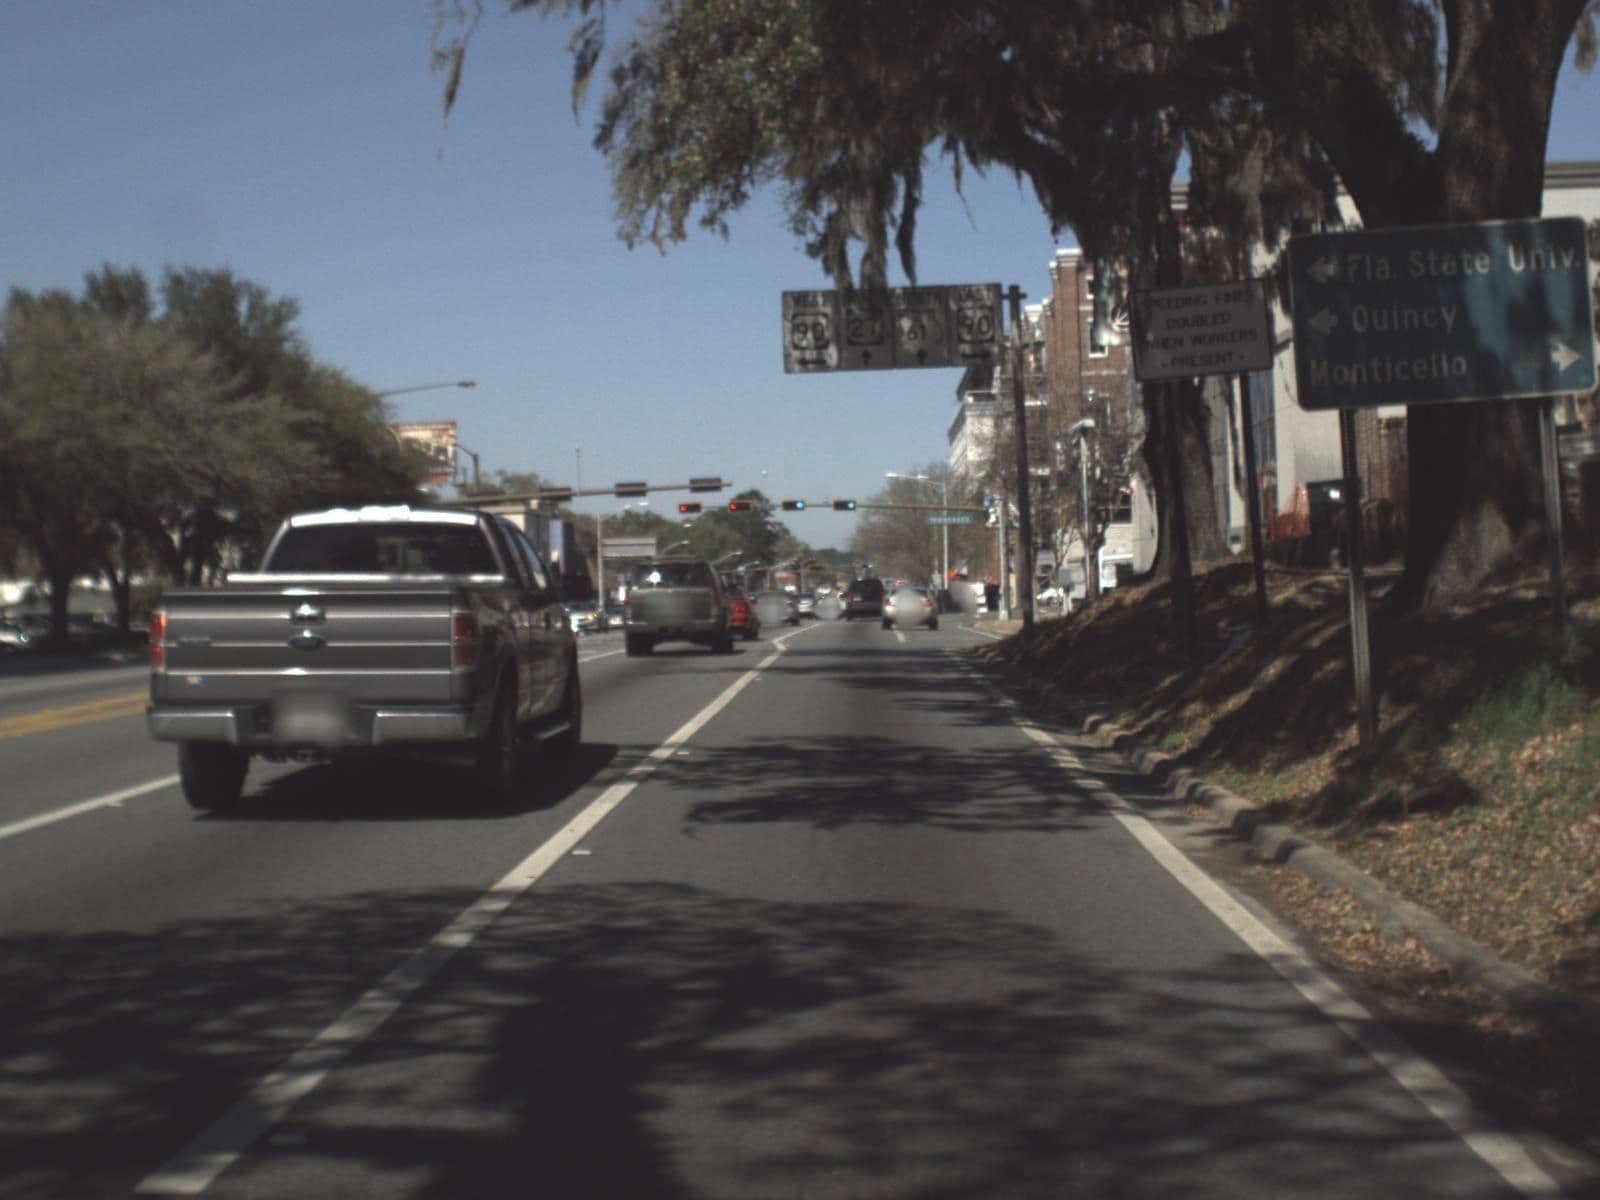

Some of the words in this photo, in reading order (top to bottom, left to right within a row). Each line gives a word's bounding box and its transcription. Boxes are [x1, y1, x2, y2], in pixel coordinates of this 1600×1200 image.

[1347, 252, 1397, 282] Fla.
[1409, 244, 1490, 279] State
[1507, 243, 1581, 274] Univ.
[960, 314, 993, 337] 90
[1166, 312, 1231, 330] DOUBLED
[1351, 303, 1457, 334] Quincy
[797, 319, 826, 345] 90
[1190, 329, 1256, 346] WORKERS
[1310, 353, 1467, 387] Monticello
